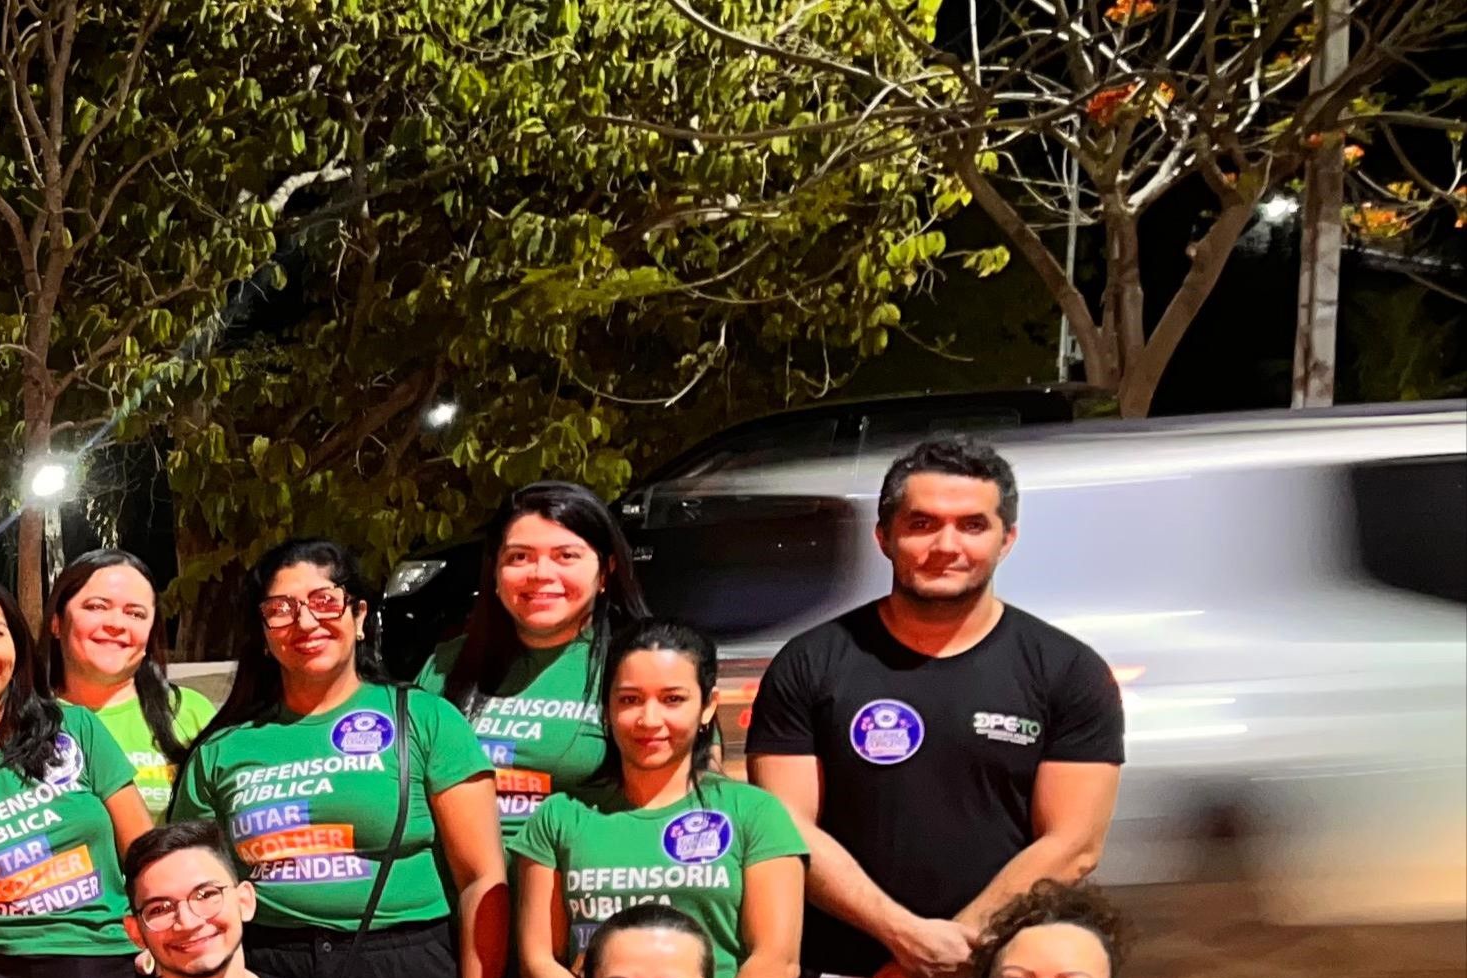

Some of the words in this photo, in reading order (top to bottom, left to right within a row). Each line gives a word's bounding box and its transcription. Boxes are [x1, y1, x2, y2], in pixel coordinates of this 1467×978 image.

[485, 697, 599, 724] FENSORIA
[475, 717, 542, 739] BLICA
[236, 754, 385, 789] DEFENSORIA
[231, 778, 333, 812] PÚBLICA
[232, 805, 301, 840] LUTAR
[240, 829, 345, 861] ACOLHER
[250, 855, 364, 880] DEFENDER
[567, 865, 730, 891] DEFENSORIA
